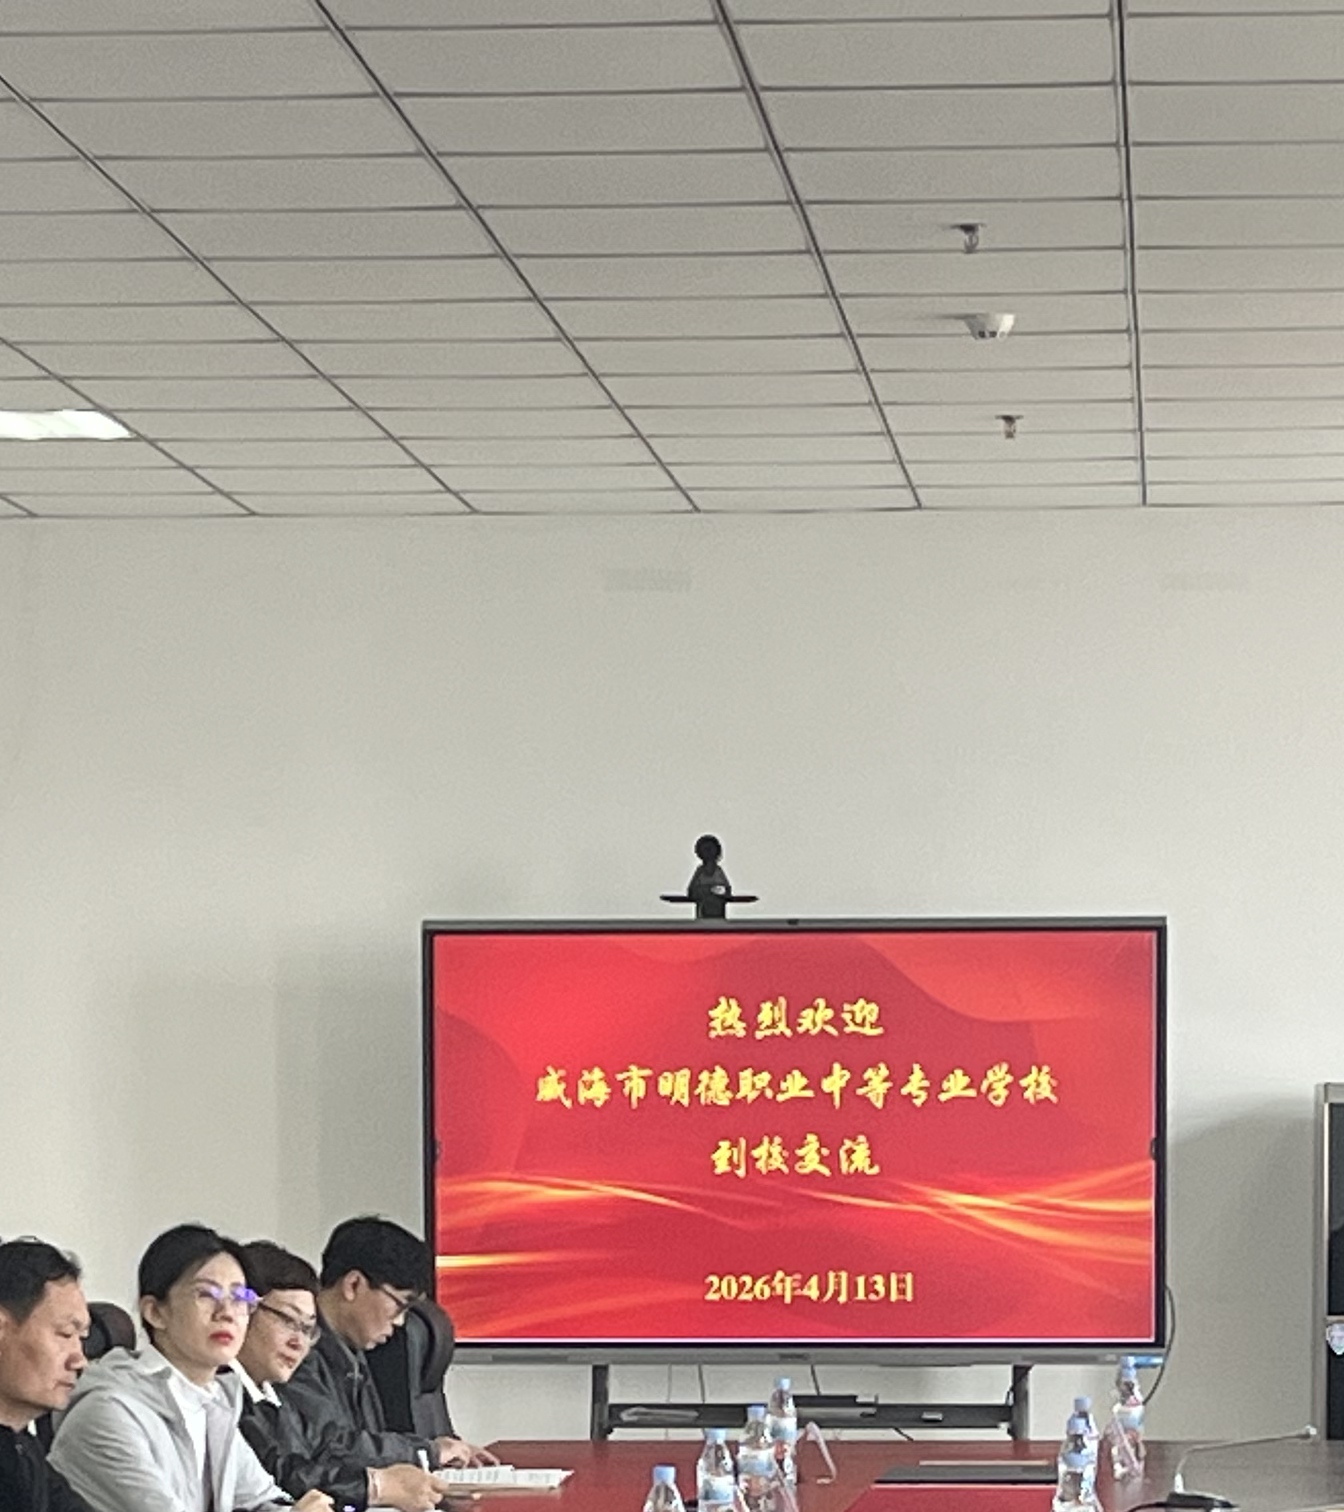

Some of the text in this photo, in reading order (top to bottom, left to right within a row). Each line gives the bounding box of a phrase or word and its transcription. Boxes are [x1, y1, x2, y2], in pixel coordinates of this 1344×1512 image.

[708, 996, 885, 1040] 热烈欢迎
[535, 1062, 1060, 1109] 威海市明德职业中等专业学校
[710, 1133, 880, 1178] 到校交流
[704, 1269, 914, 1304] 2026年4月13日
